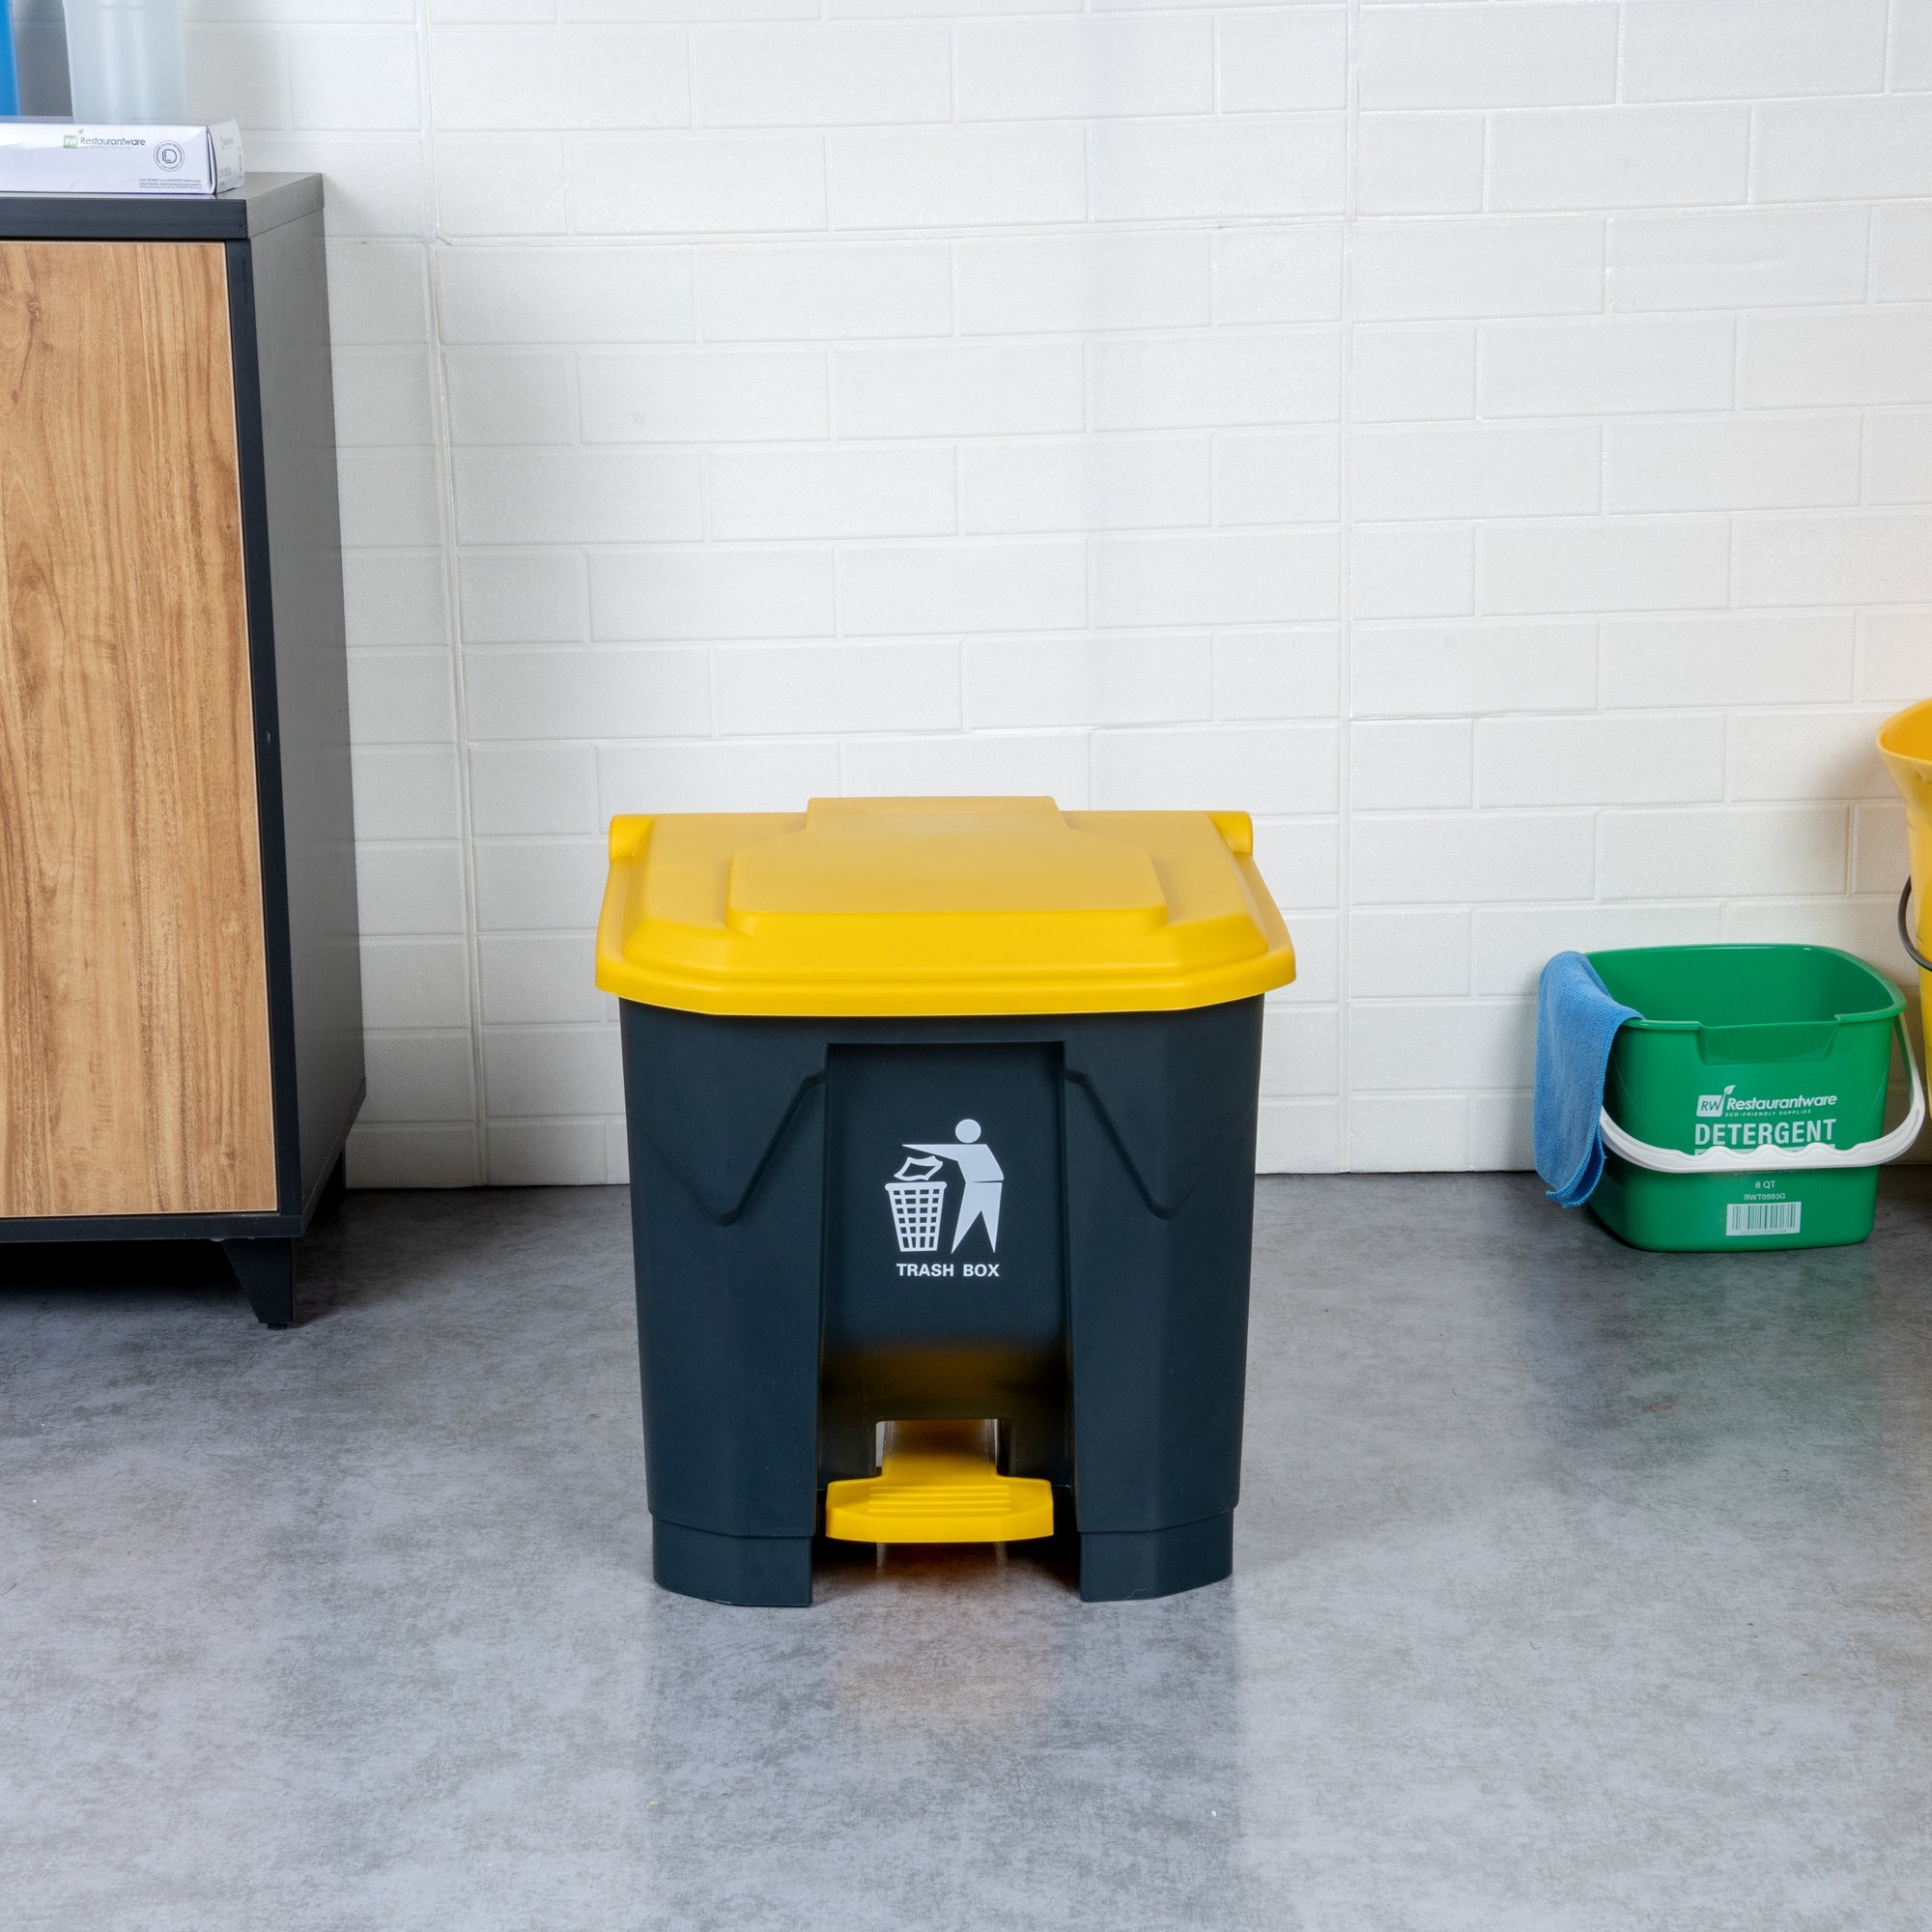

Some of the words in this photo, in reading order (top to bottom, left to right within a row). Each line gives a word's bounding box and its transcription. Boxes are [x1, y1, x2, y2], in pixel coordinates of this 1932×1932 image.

[80, 136, 146, 146] Restaurantware
[1700, 1100, 1721, 1112] RW
[1726, 1094, 1837, 1111] Restaurantware
[1694, 1119, 1836, 1146] DETERGENT
[1754, 1180, 1761, 1189] 8
[1763, 1179, 1776, 1189] QT
[1744, 1192, 1786, 1201] RWT0593G
[895, 1263, 954, 1277] TRASH
[963, 1263, 1001, 1277] BOX
